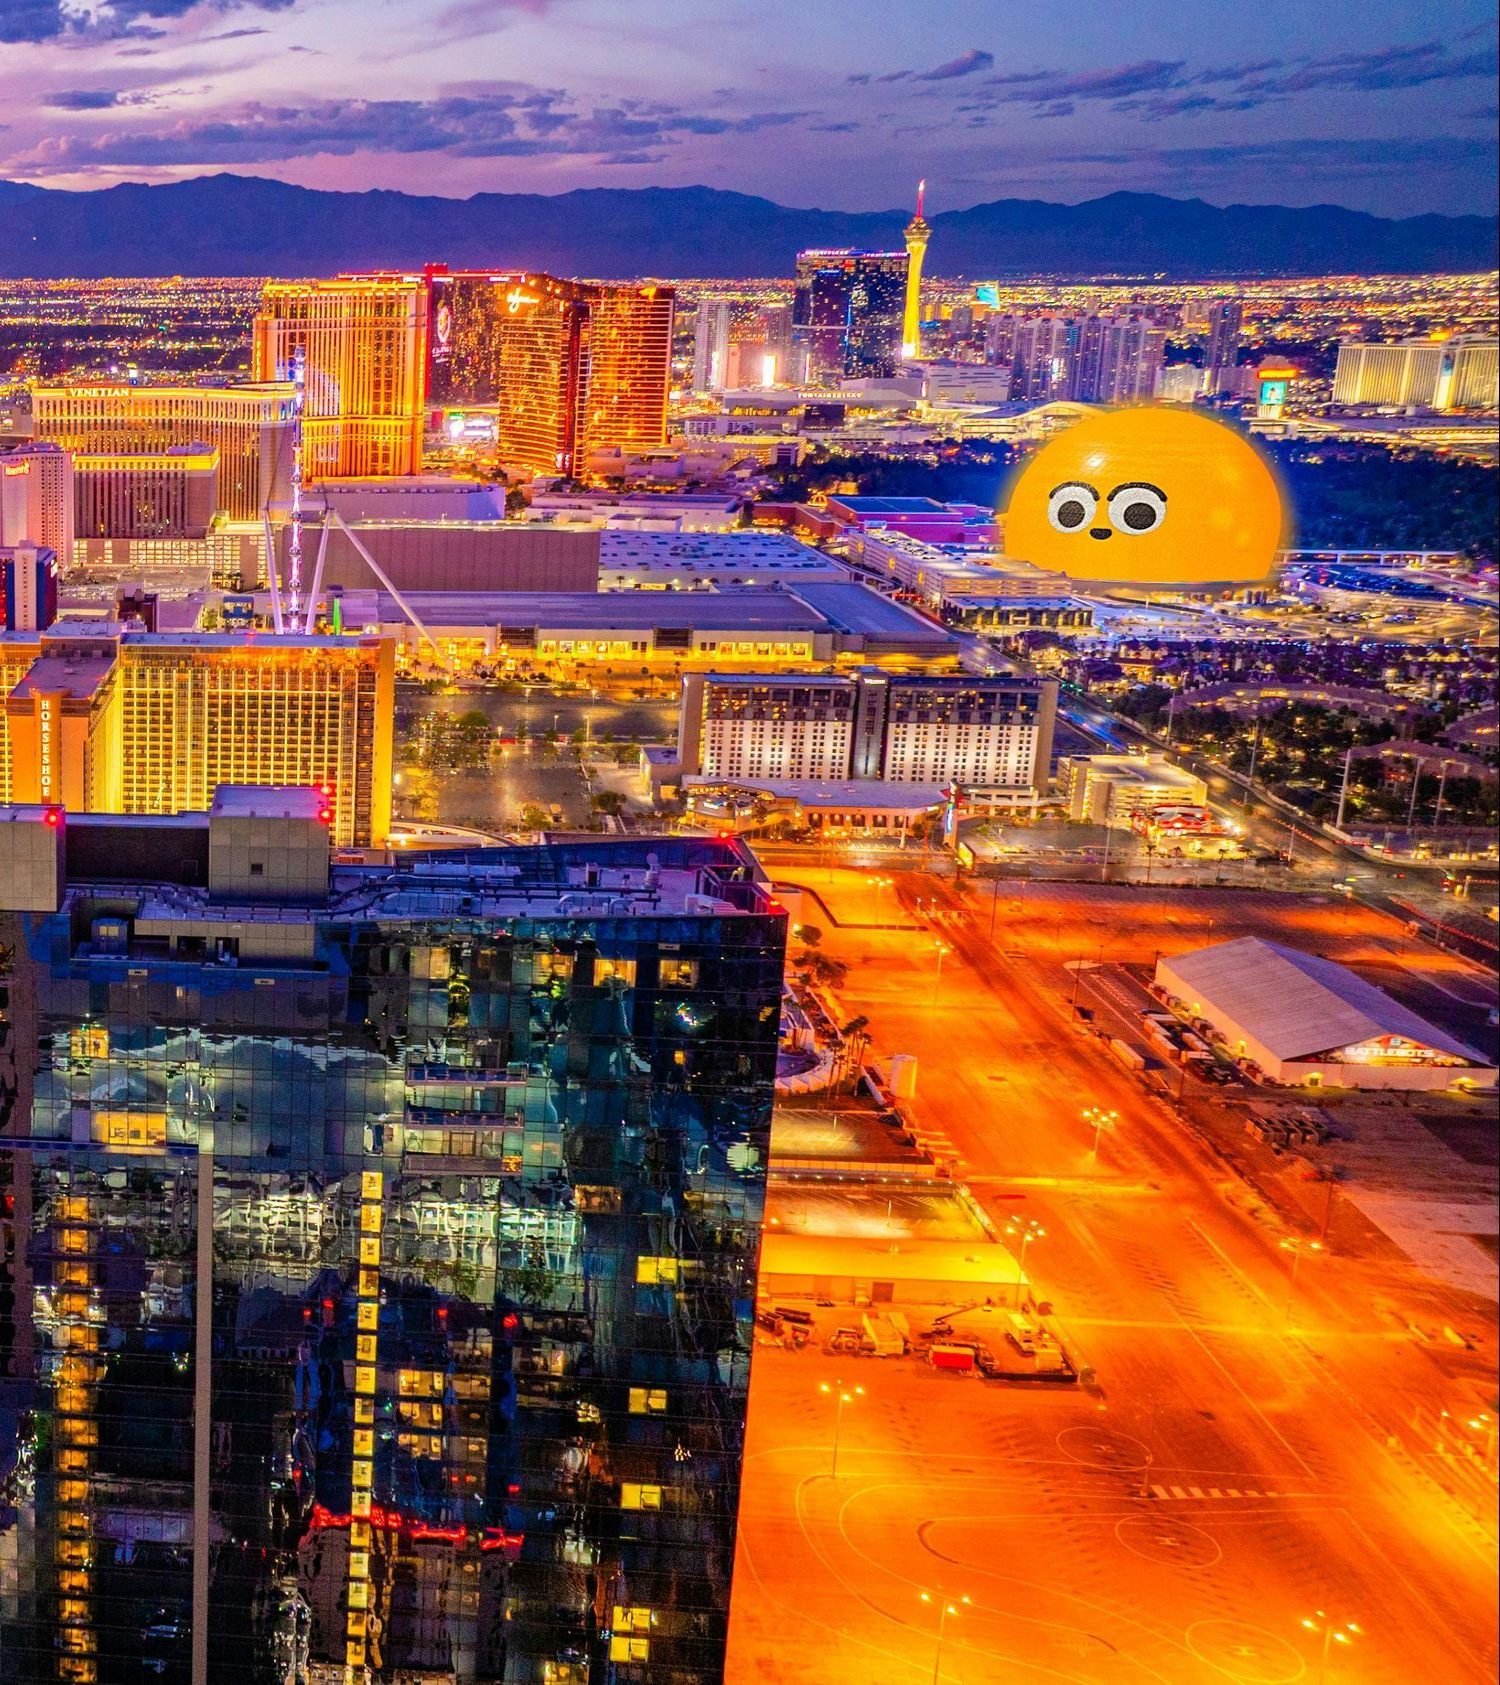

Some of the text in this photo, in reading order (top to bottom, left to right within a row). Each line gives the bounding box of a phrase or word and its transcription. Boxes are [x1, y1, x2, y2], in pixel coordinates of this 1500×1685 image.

[69, 387, 130, 398] VENETIAN
[41, 700, 52, 797] HORSESHOE
[1344, 1047, 1435, 1058] BATTLEBOTS
